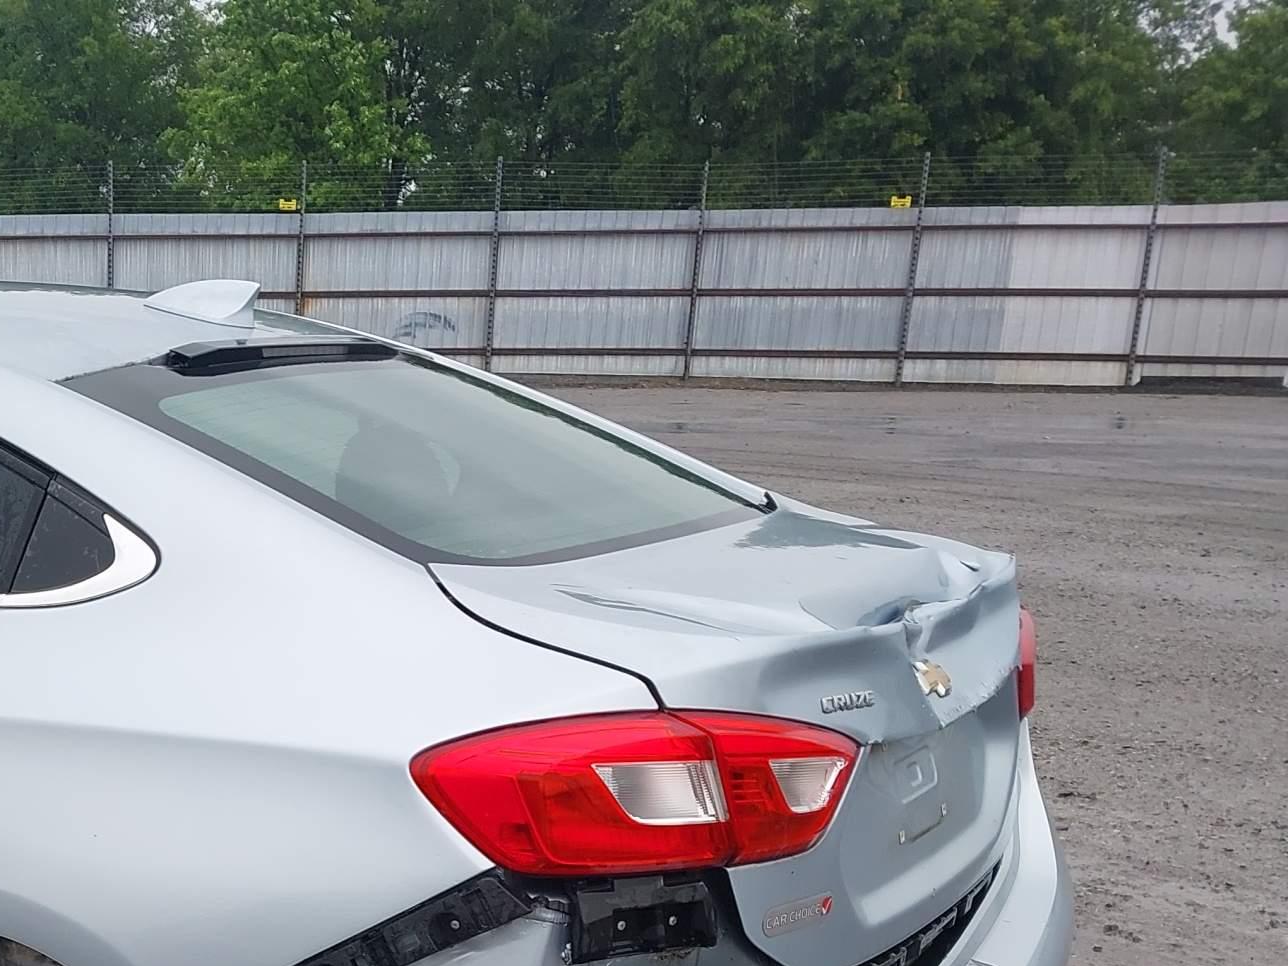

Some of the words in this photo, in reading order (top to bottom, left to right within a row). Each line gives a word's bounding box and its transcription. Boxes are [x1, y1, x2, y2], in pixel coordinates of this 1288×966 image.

[821, 690, 875, 714] CRUZE
[766, 914, 788, 929] CAR
[789, 903, 821, 922] CHOICE
